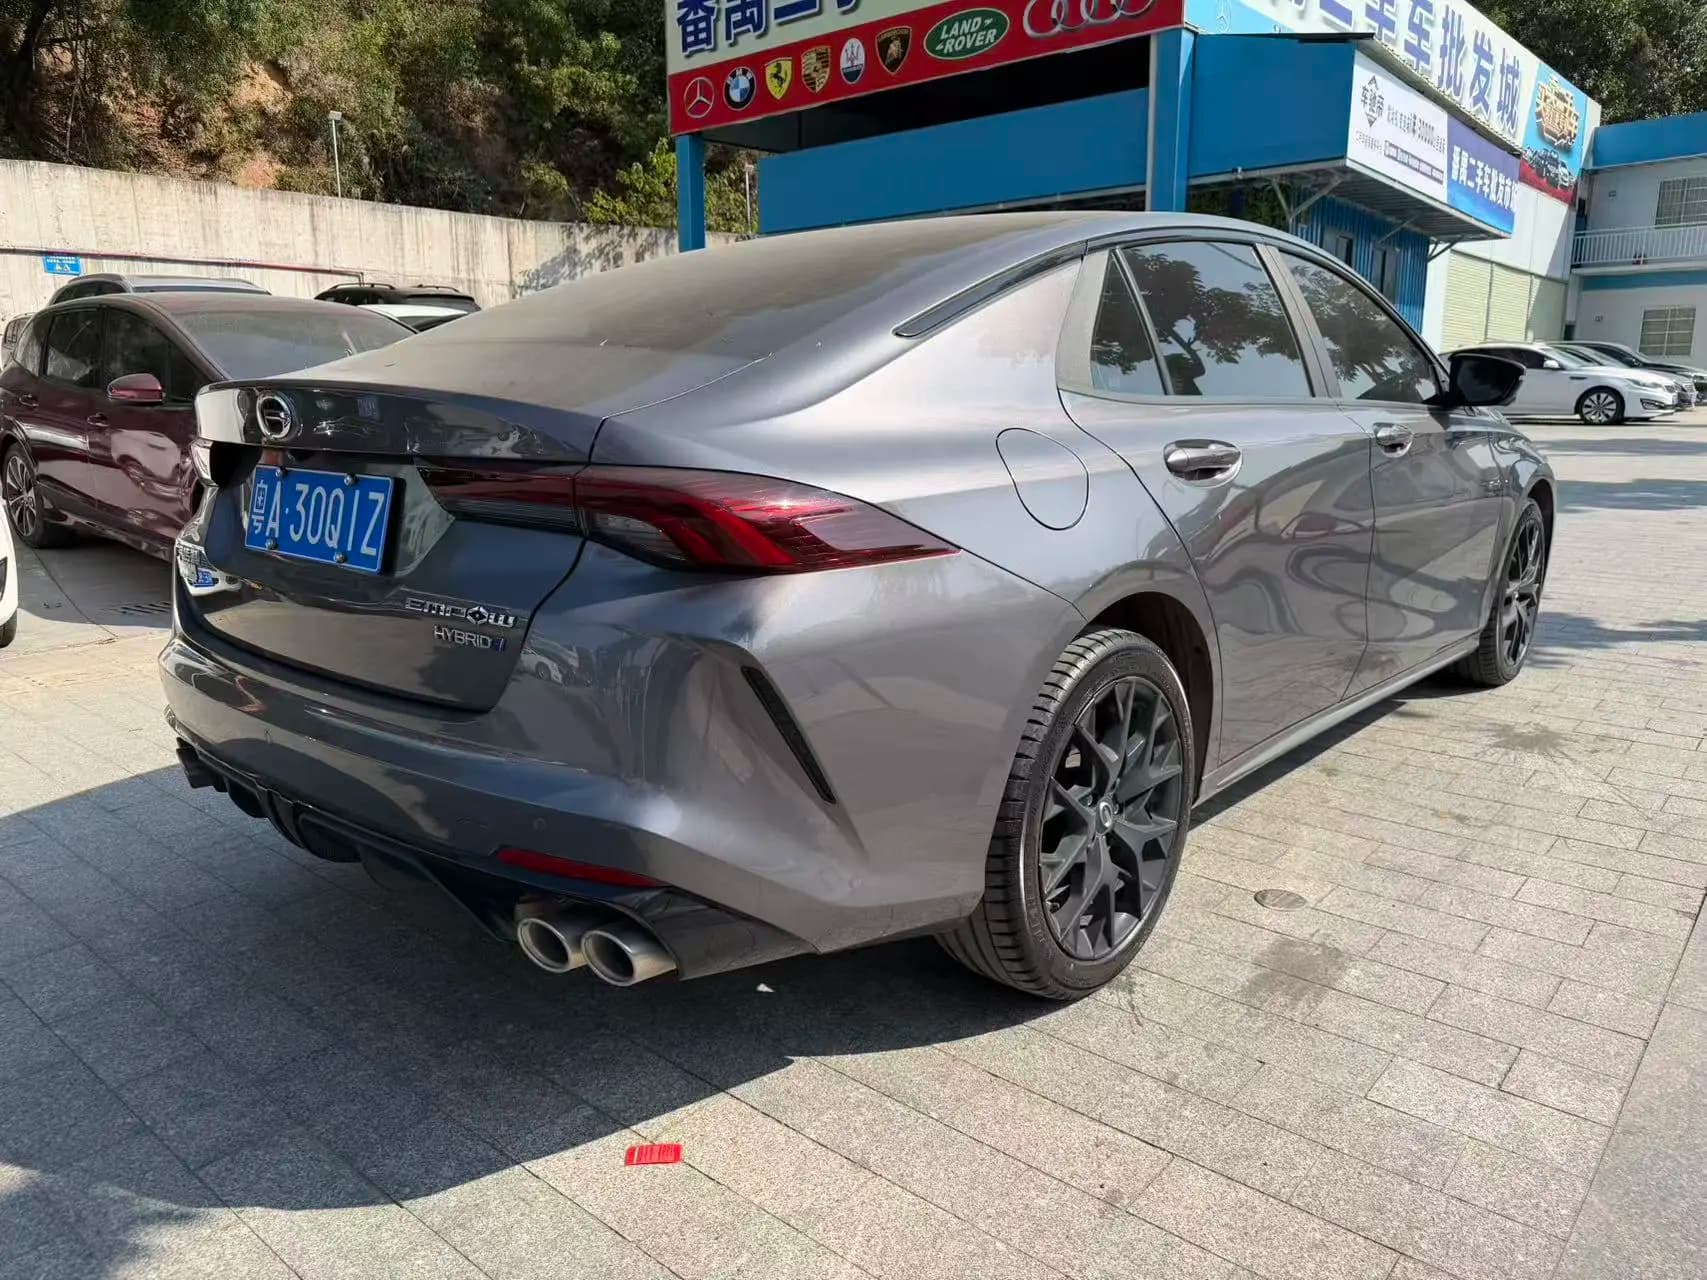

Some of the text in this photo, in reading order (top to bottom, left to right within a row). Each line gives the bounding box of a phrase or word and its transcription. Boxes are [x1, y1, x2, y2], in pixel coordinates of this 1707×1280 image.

[940, 15, 981, 40] LAND
[943, 29, 997, 54] ROVER
[433, 625, 492, 649] HYBRID
